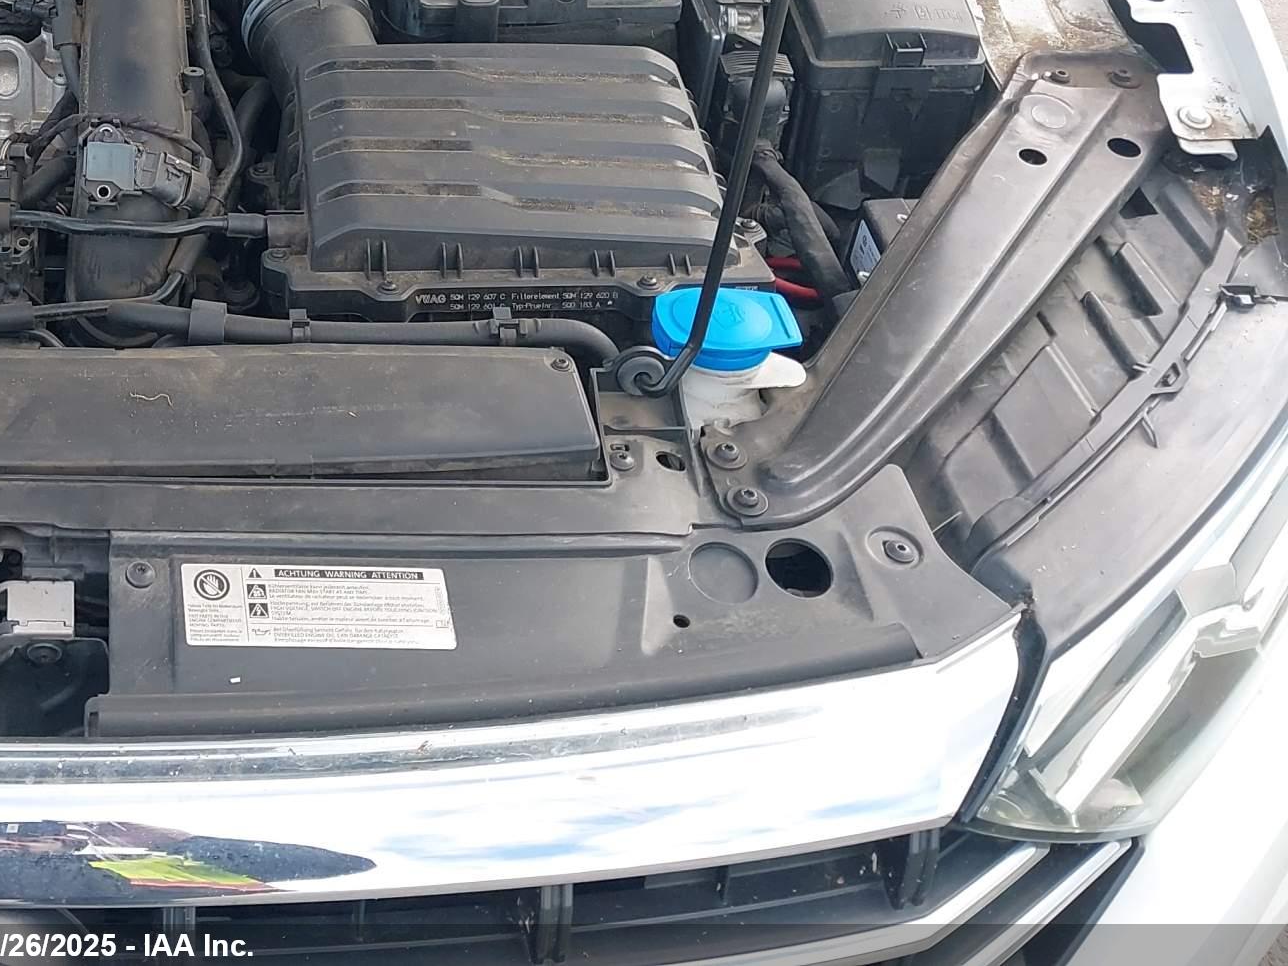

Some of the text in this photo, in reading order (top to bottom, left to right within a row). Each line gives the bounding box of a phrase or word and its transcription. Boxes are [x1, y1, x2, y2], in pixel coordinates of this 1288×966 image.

[278, 569, 418, 580] ACHTUNG WARNING ATTENTION
